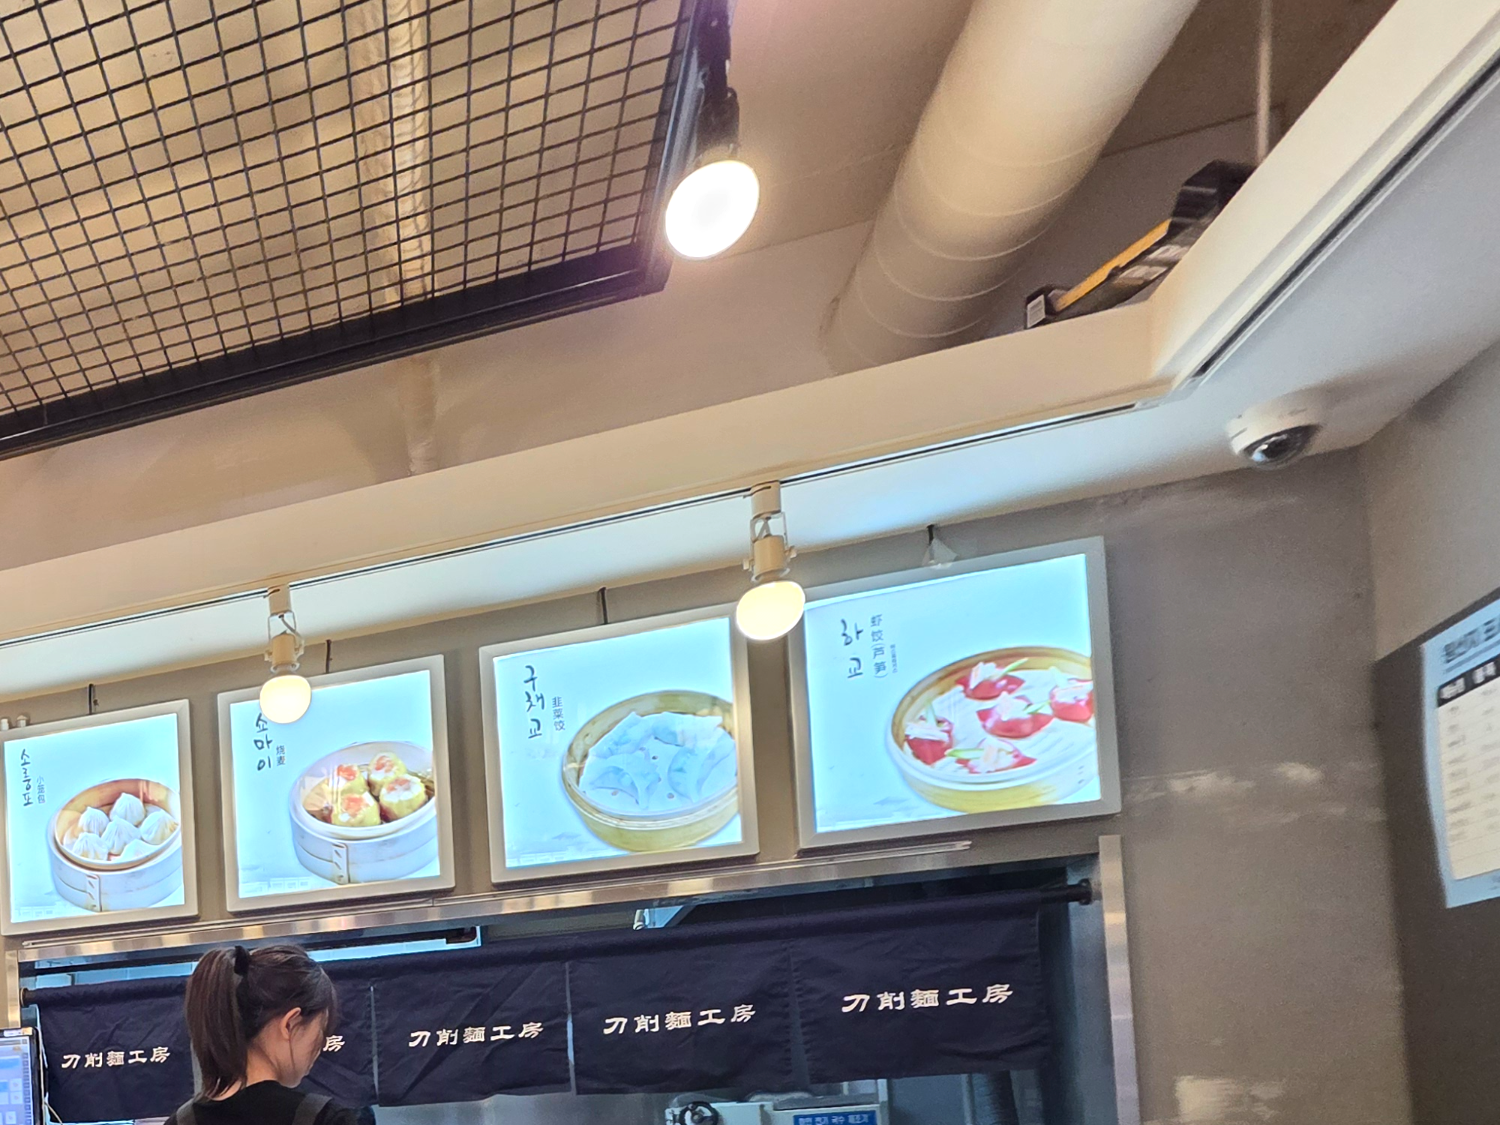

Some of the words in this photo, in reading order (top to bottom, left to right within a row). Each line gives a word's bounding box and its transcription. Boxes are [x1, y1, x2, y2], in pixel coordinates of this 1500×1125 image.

[840, 618, 864, 679] 하교
[523, 664, 545, 739] 구채교
[841, 983, 1014, 1013] 刀削麵工房
[408, 1021, 544, 1048] 刀削麵工房
[603, 1004, 756, 1035] 刀削麵工房
[61, 1046, 171, 1069] 刀削麵工房
